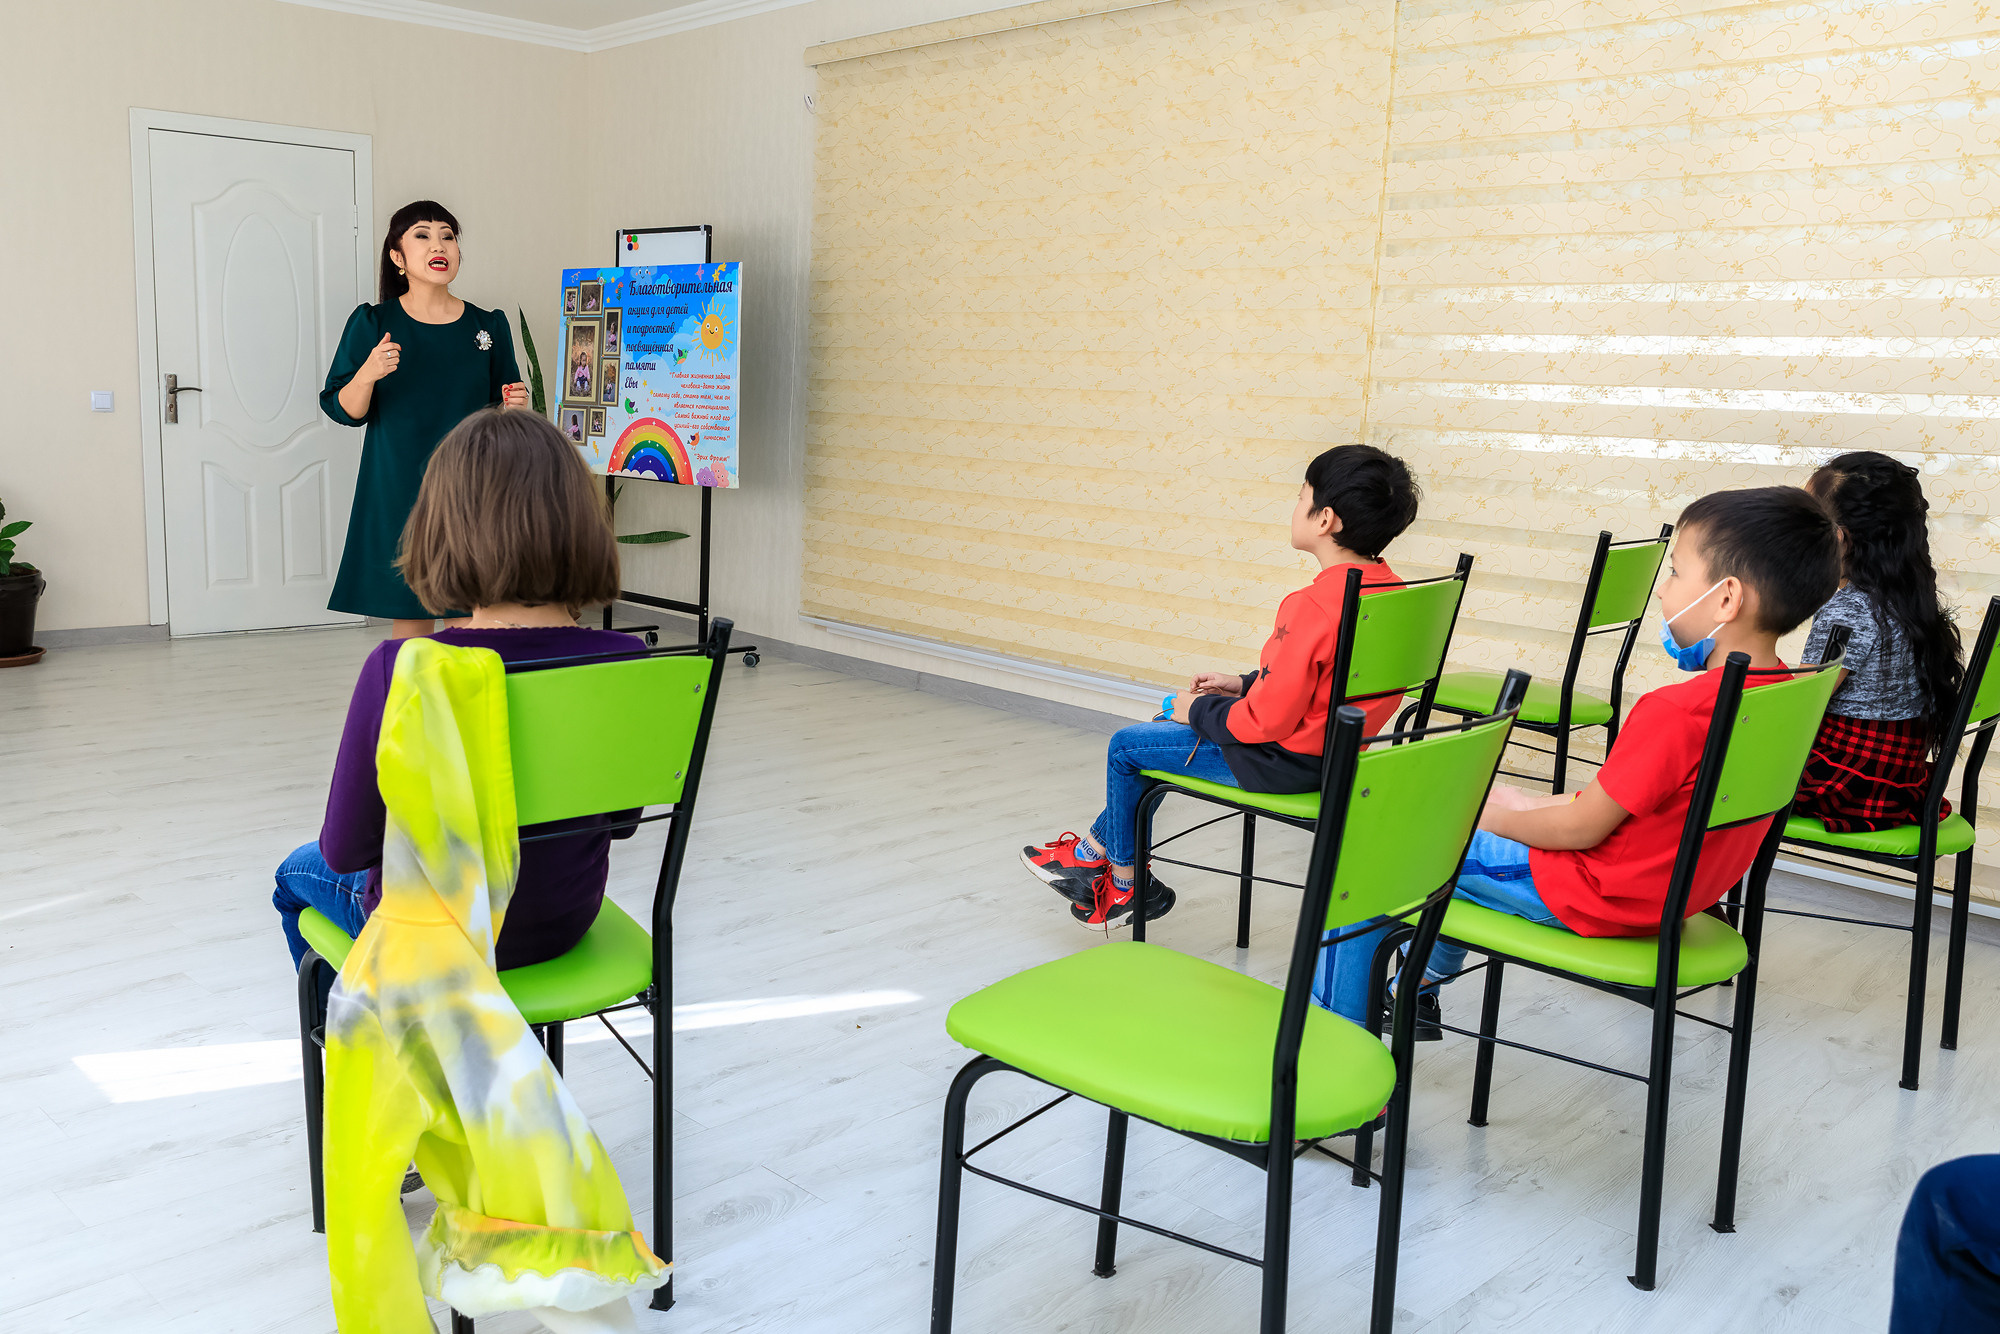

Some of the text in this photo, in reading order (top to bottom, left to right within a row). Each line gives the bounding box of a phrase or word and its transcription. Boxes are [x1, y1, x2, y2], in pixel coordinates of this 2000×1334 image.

[629, 279, 732, 298] Благотворительная
[628, 303, 689, 318] акция для детей
[632, 322, 677, 337] подростков,
[626, 341, 673, 354] посвящённая
[625, 362, 656, 370] памяти
[625, 377, 638, 388] Евы
[691, 412, 709, 420] важный
[701, 423, 730, 431] собственная
